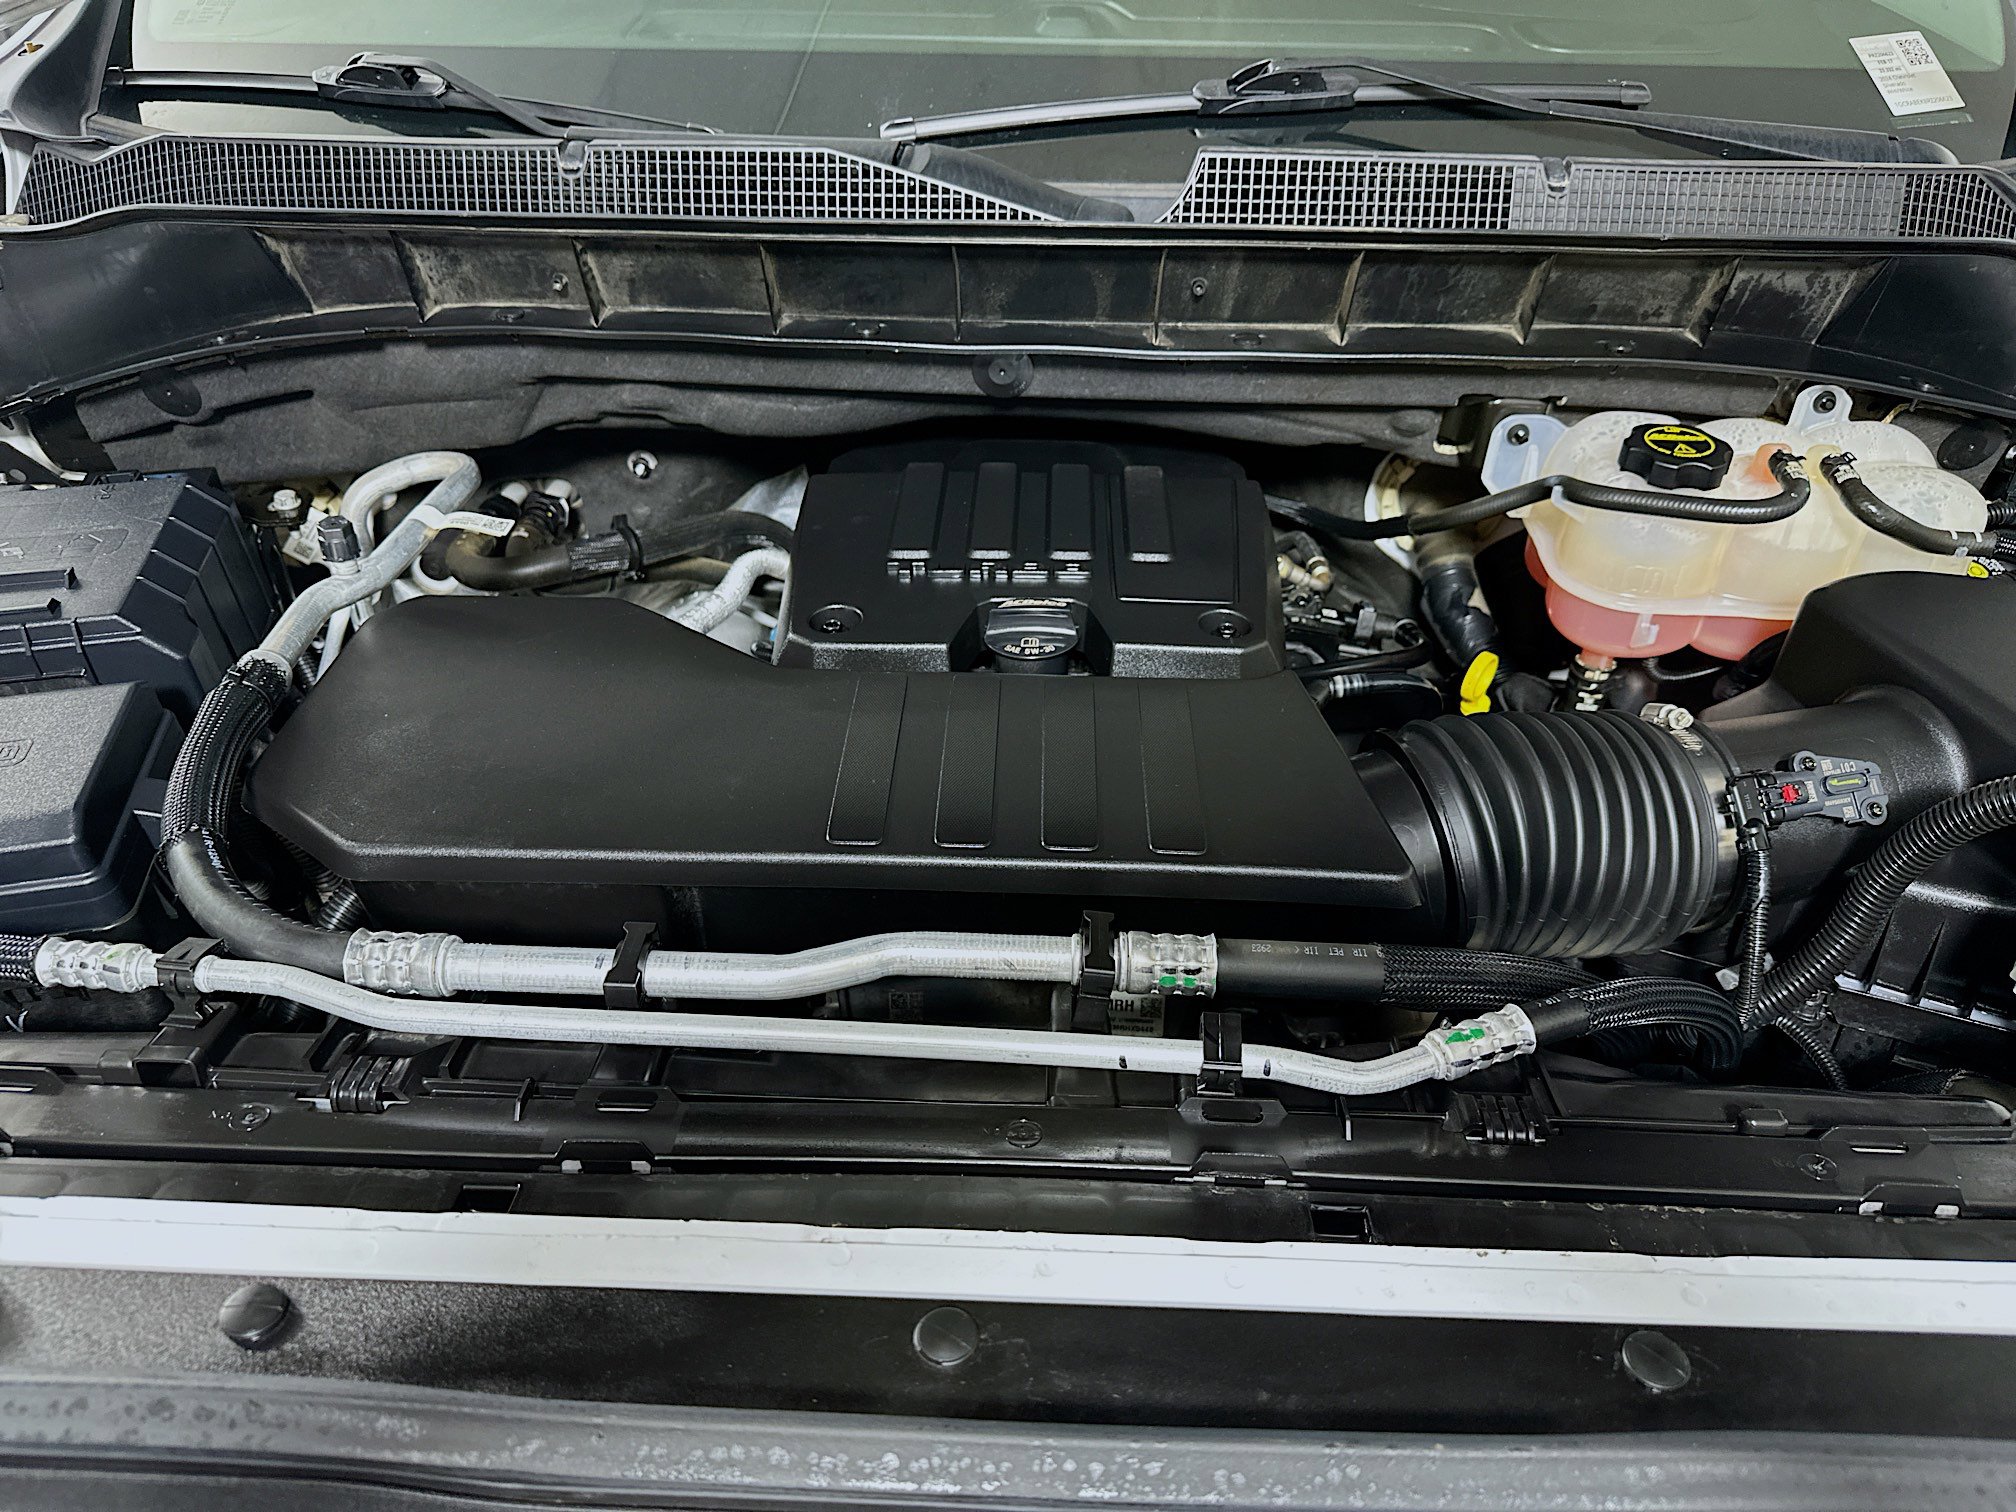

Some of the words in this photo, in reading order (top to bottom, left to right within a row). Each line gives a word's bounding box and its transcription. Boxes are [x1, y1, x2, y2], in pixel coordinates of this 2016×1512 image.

[998, 598, 1067, 608] ACDelco
[1003, 644, 1021, 654] SAE
[1024, 644, 1056, 655] 5W-30
[1251, 943, 1272, 953] 2923
[1328, 946, 1345, 956] PET
